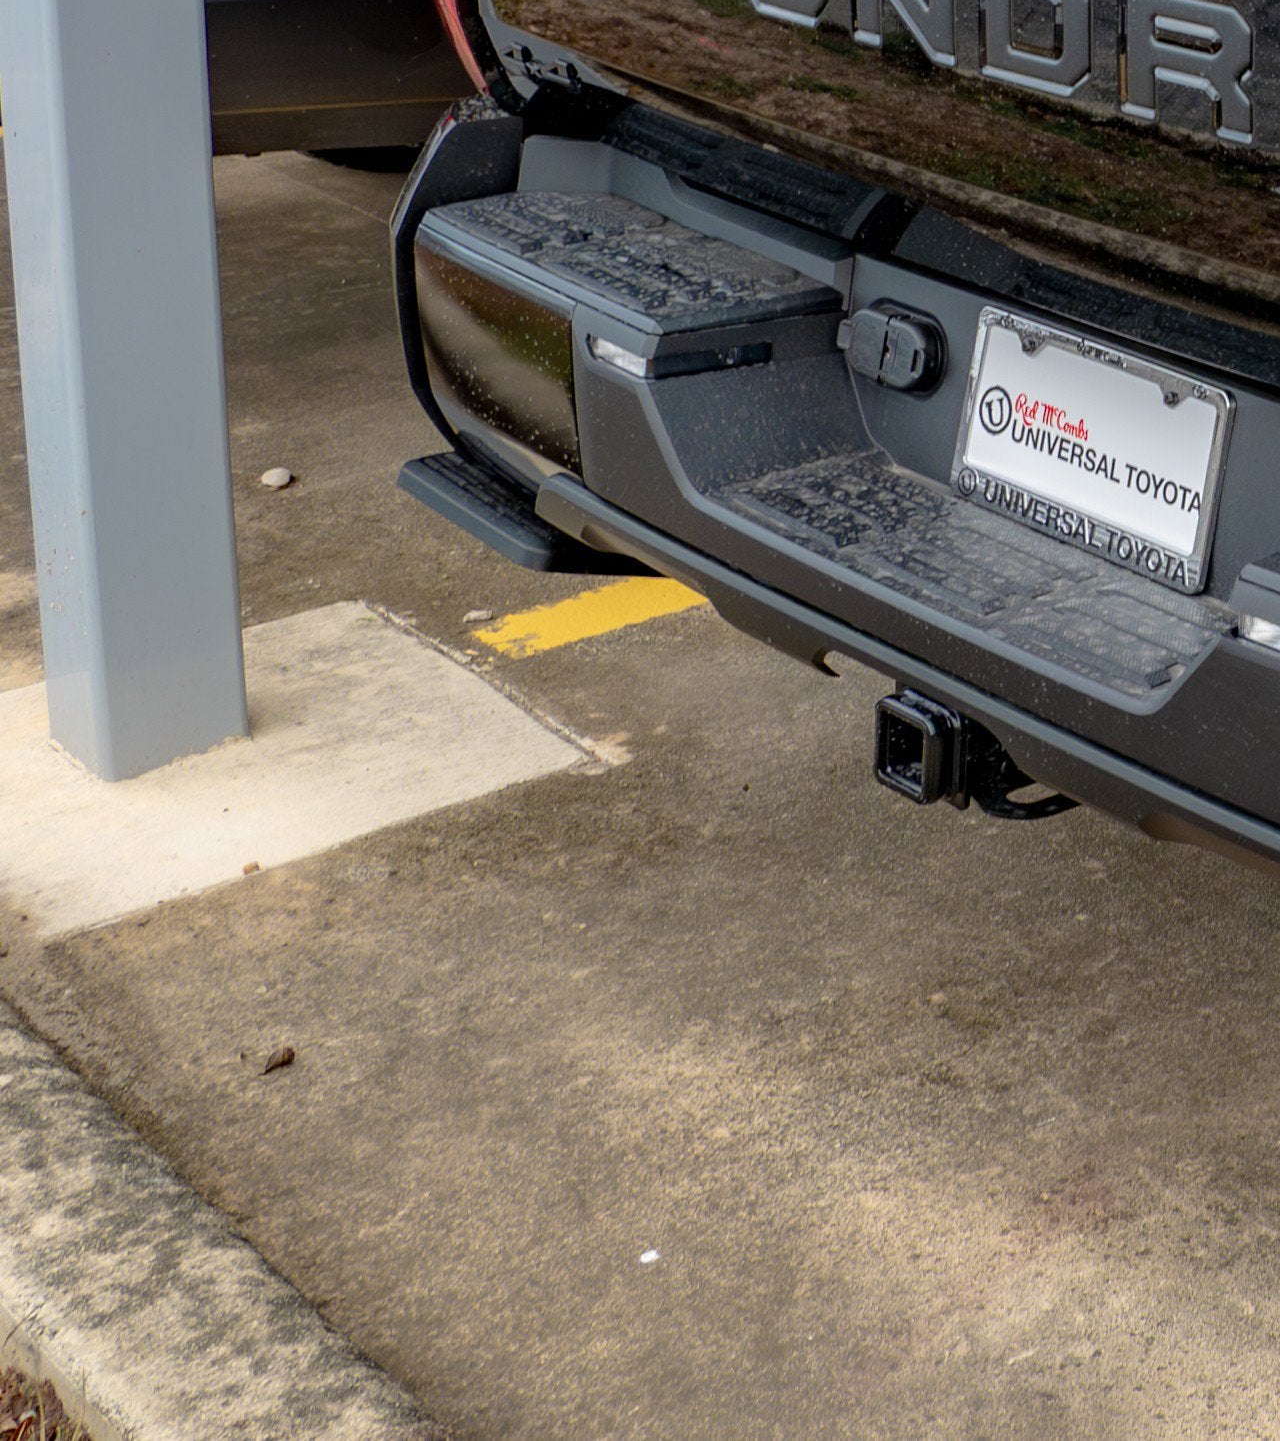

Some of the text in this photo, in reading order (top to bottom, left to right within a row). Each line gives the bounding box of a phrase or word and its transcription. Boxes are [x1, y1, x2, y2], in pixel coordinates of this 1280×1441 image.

[1015, 392, 1039, 426] Red
[1011, 418, 1201, 514] UNIVERSAL TOYOTA
[983, 478, 1190, 588] UNIVERSAL TOYOTA
